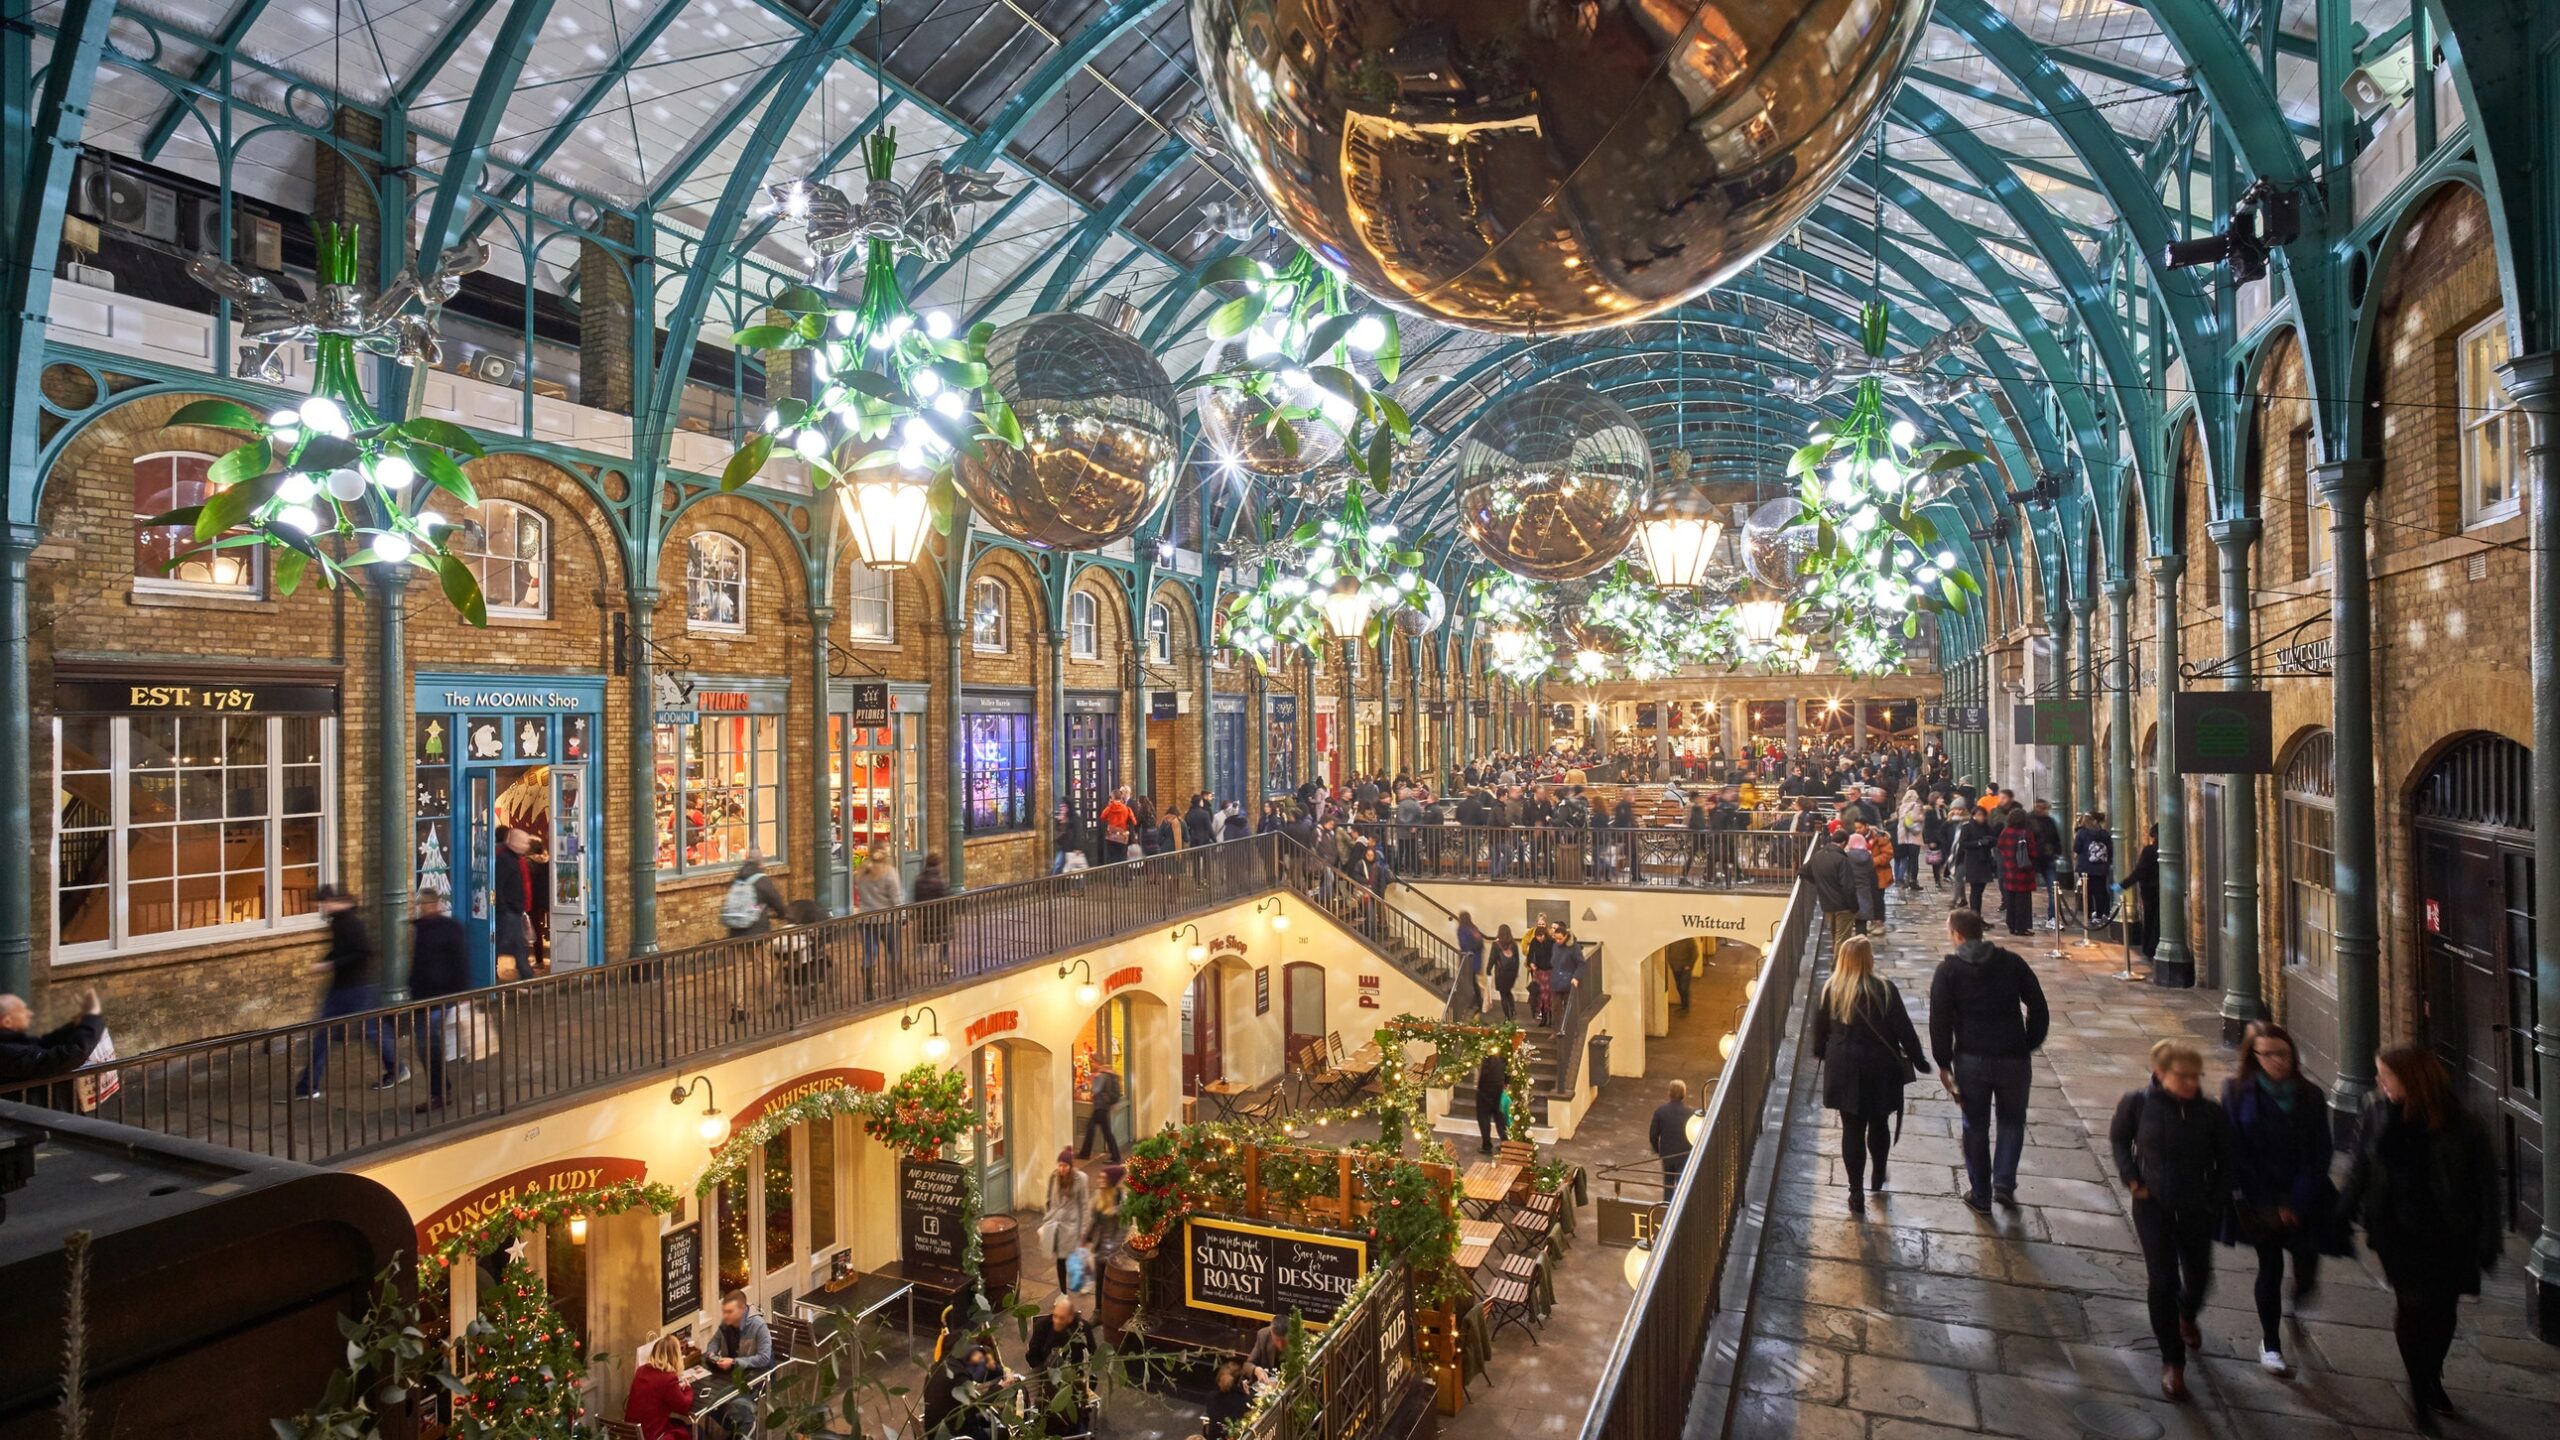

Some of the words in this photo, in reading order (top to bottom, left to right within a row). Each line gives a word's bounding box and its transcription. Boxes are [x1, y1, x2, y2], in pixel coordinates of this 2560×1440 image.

[130, 687, 191, 706] EST.
[202, 689, 255, 711] 1787
[445, 691, 471, 707] The
[475, 692, 543, 707] MOOMIN
[547, 692, 579, 709] Shop
[697, 692, 750, 711] PYLONES
[659, 713, 690, 723] MOOMIN
[856, 709, 885, 720] PYLONES
[1682, 914, 1745, 930] Whittard
[1210, 938, 1224, 955] Pie
[1226, 935, 1247, 955] Shop
[1104, 967, 1143, 995] PYLONES
[965, 1010, 1018, 1046] PYLONES
[764, 1076, 844, 1115] WHISKIES
[908, 1169, 922, 1178] NO
[922, 1171, 960, 1184] DRINKS
[914, 1180, 953, 1193] BEYOND
[426, 1186, 515, 1245] PUNCH
[549, 1168, 604, 1193] JUDY
[906, 1190, 929, 1201] THIS
[930, 1194, 963, 1206] POINT
[670, 1237, 691, 1252] PUNCH
[673, 1245, 691, 1259] JUDY
[1292, 1243, 1313, 1263] Save
[671, 1255, 688, 1269] FREE
[1197, 1245, 1268, 1274] SUNDAY
[1203, 1267, 1263, 1295] ROAST
[1278, 1266, 1355, 1297] DESSERT
[669, 1283, 691, 1302] HERE
[1380, 1309, 1406, 1364] PUB
